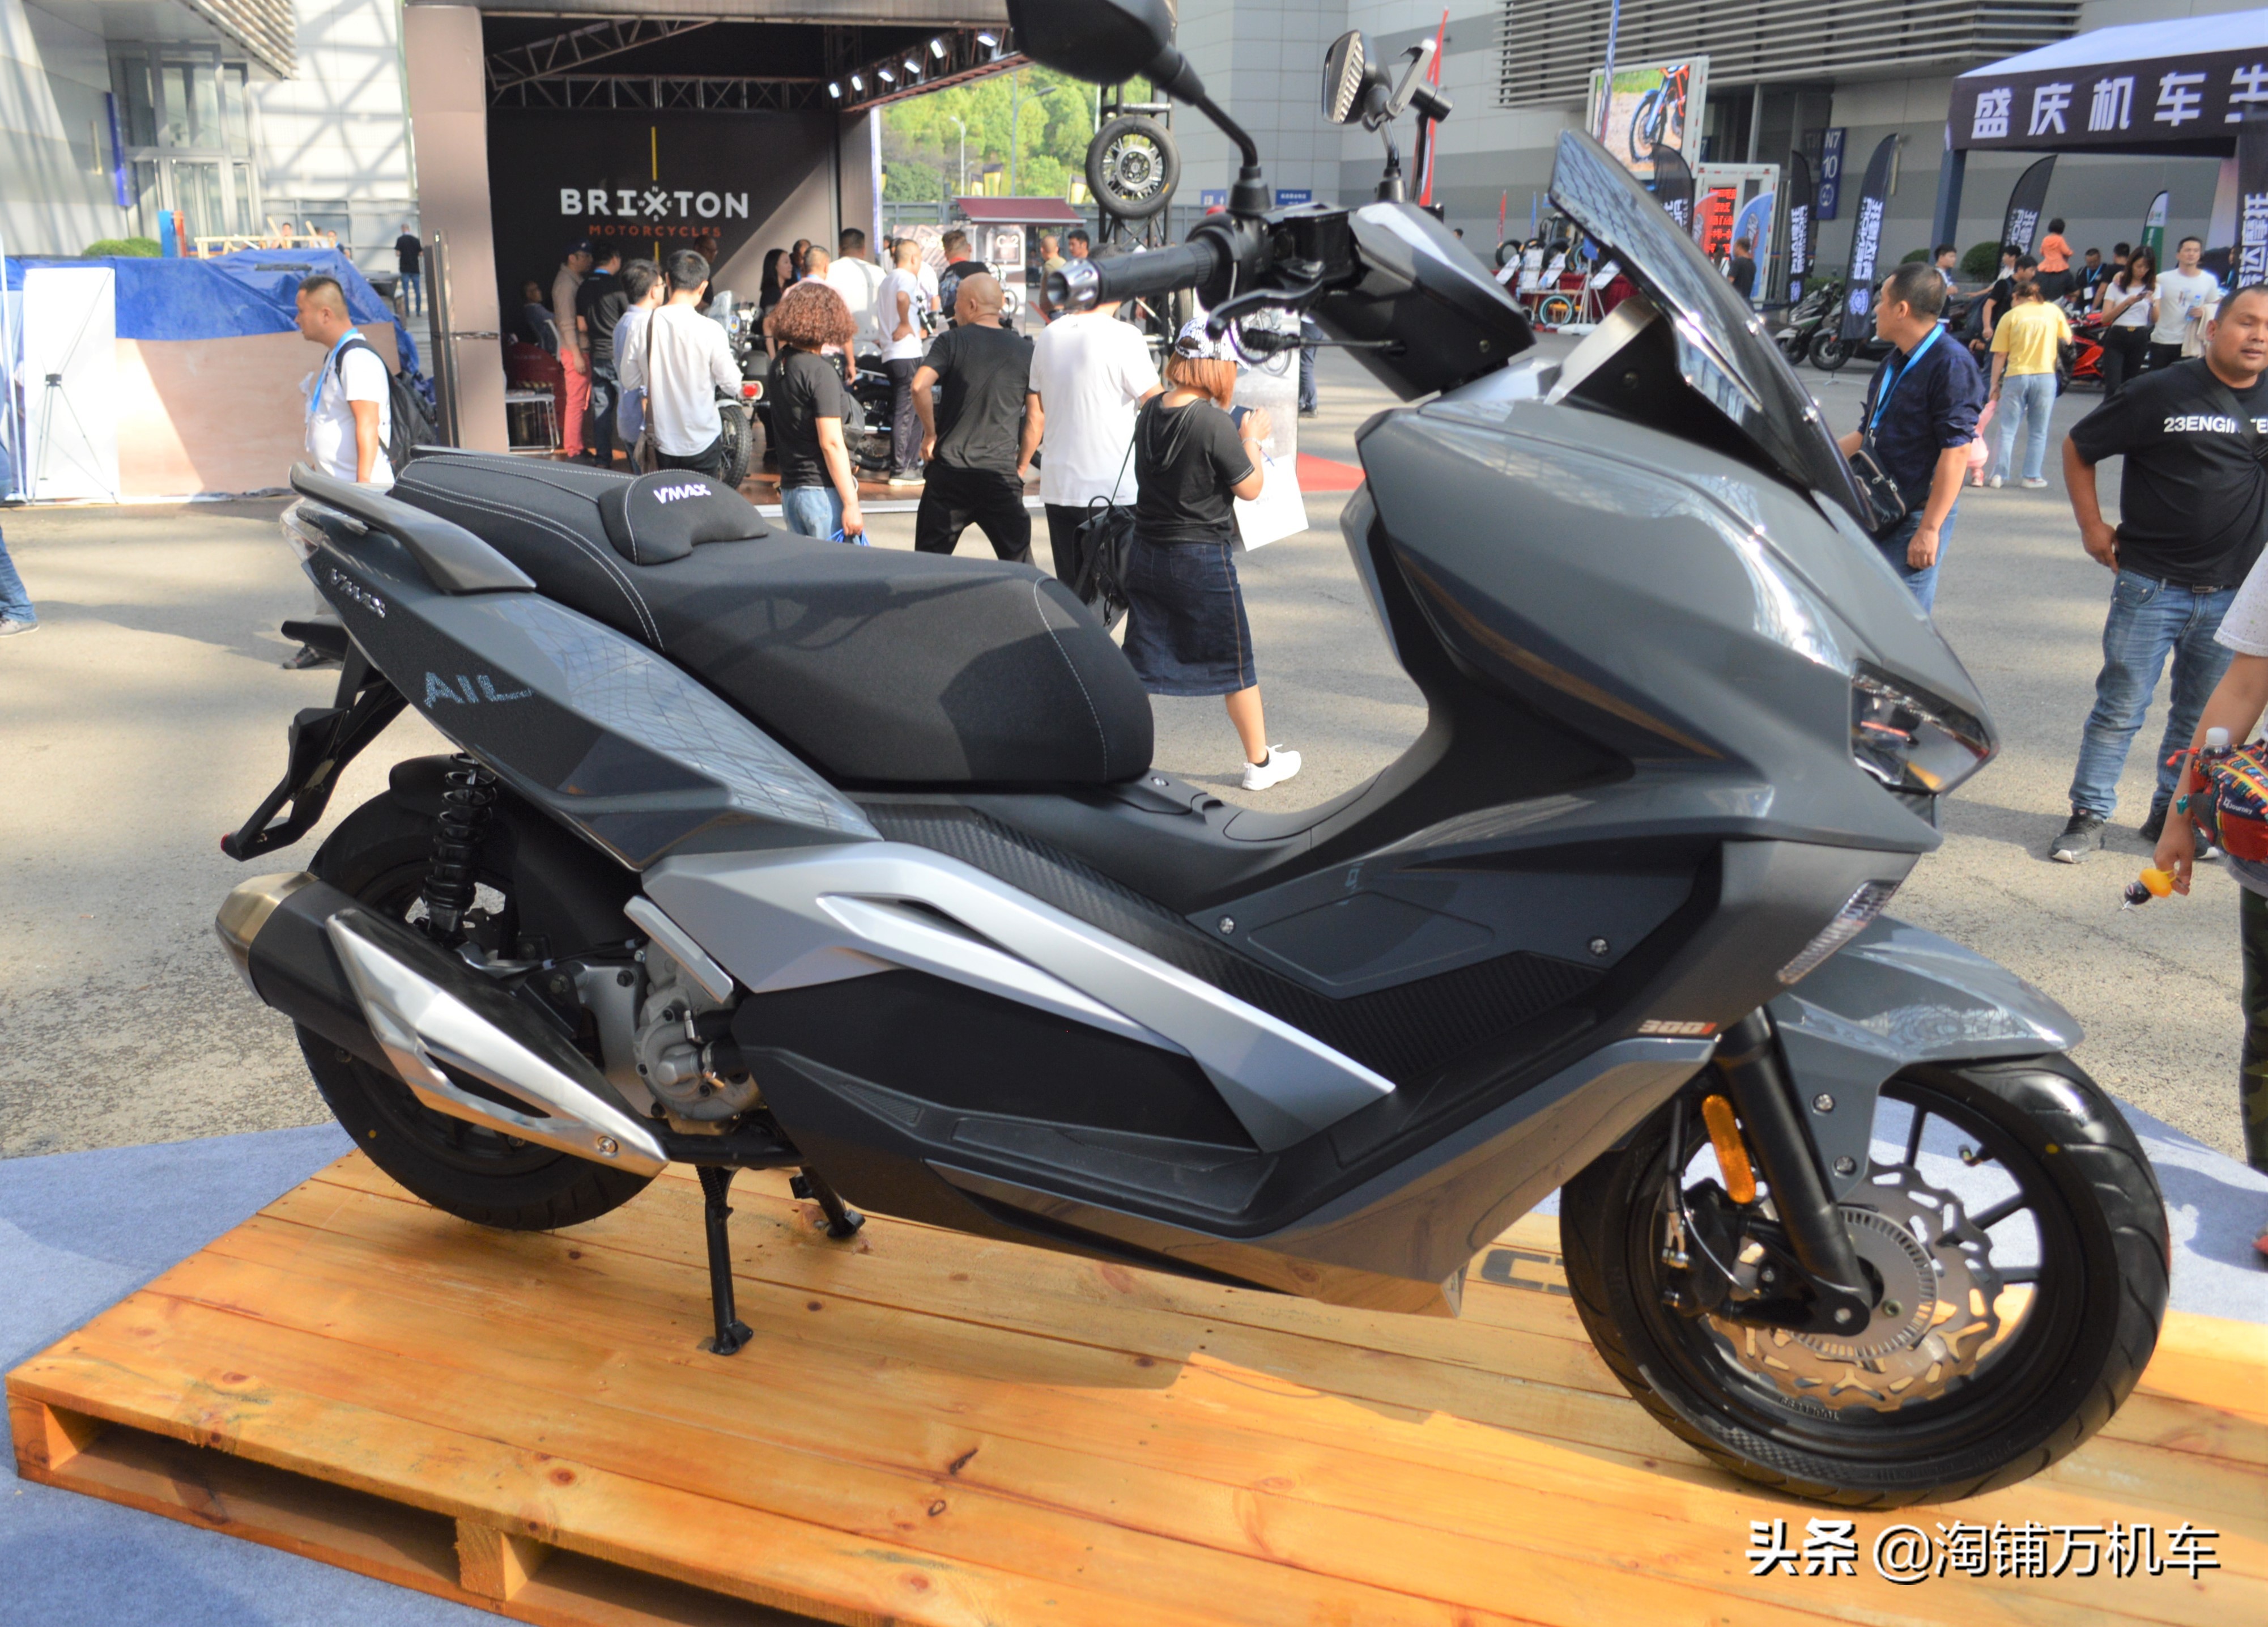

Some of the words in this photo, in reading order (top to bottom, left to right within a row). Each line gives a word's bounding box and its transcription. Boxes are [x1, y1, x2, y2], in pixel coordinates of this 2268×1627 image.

[1824, 131, 1841, 148] N7
[1823, 155, 1838, 179] 10
[560, 188, 748, 218] BRIXTON
[589, 224, 721, 237] MOTORCYCLES
[653, 484, 712, 504] VMAX
